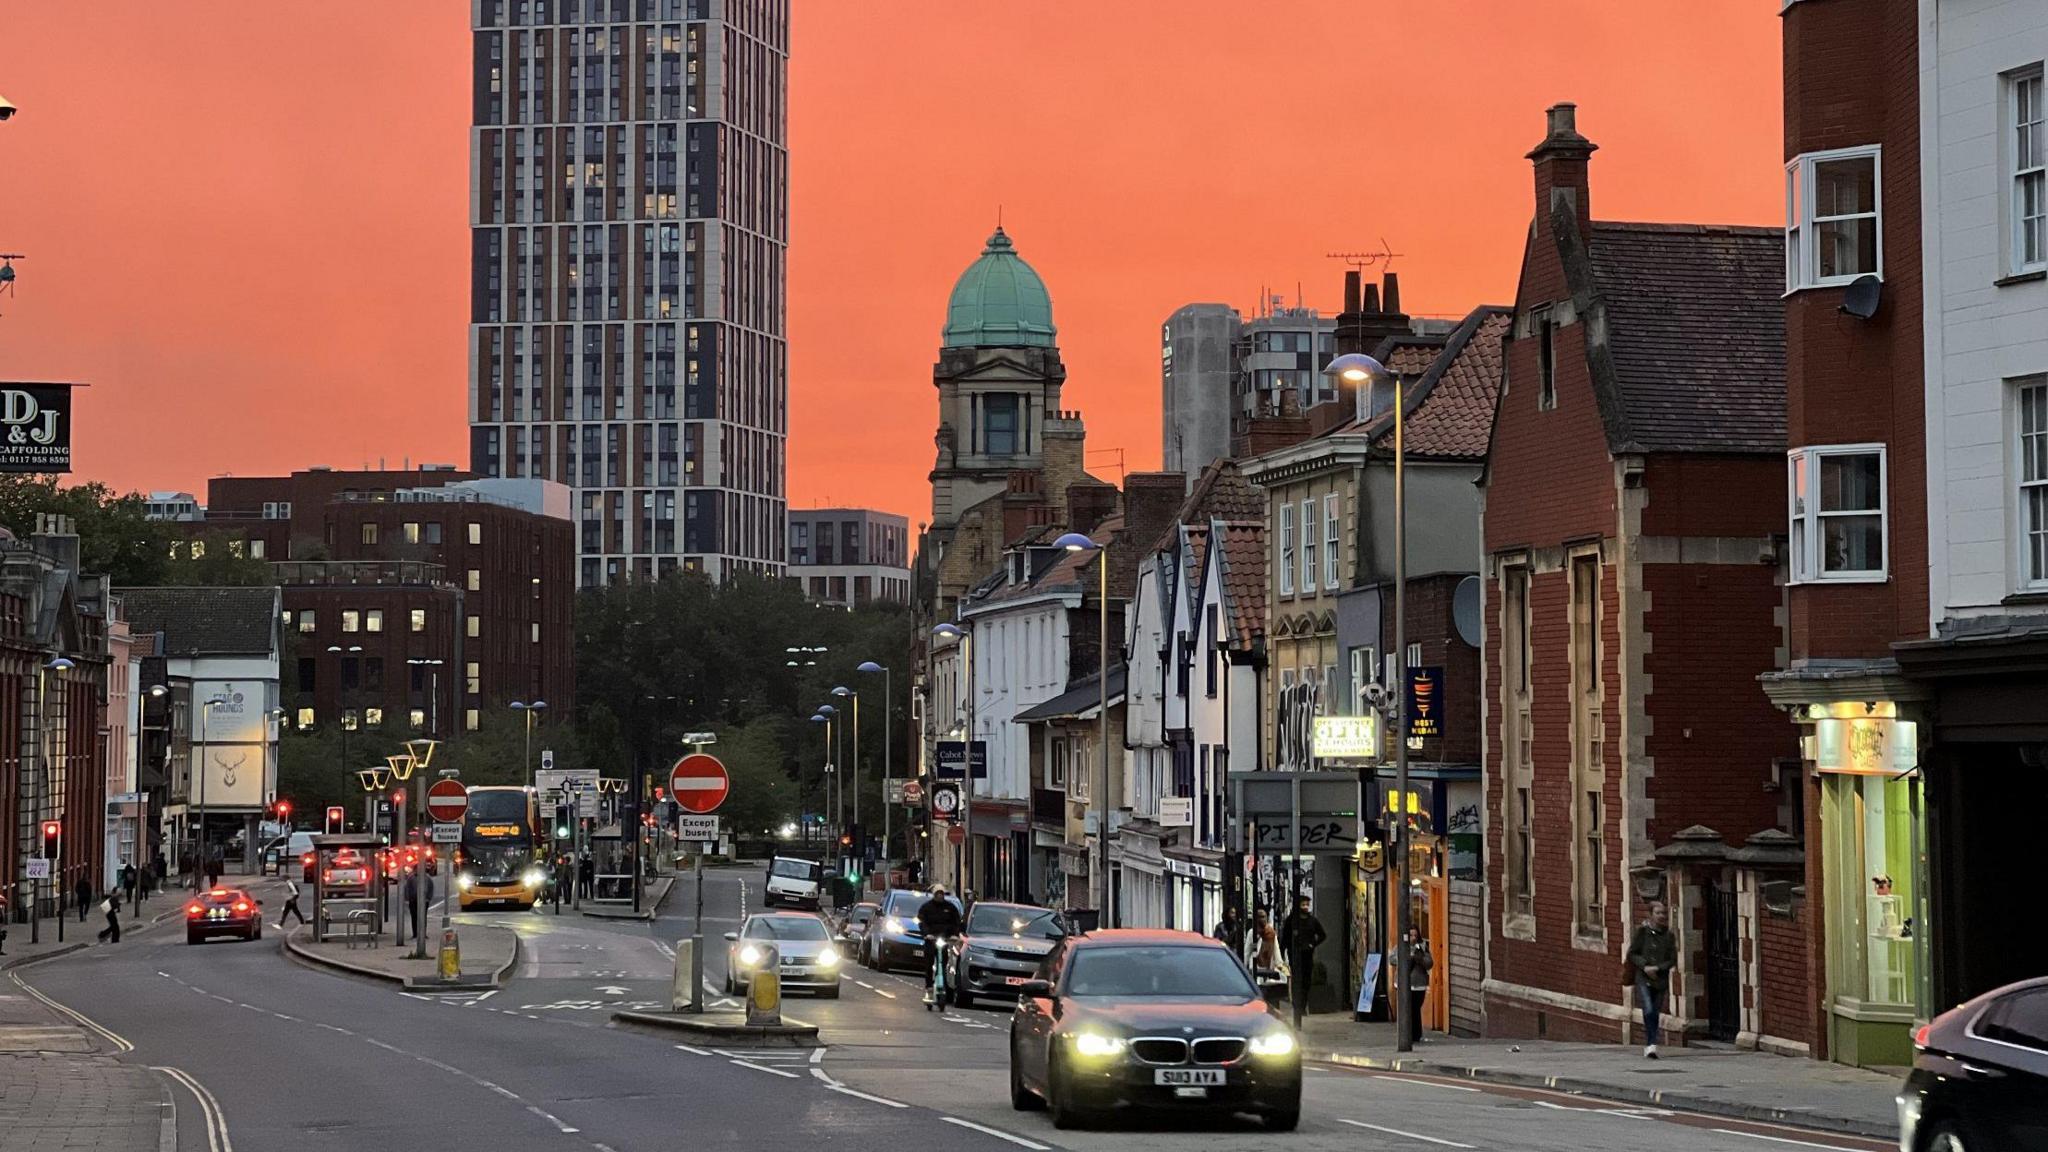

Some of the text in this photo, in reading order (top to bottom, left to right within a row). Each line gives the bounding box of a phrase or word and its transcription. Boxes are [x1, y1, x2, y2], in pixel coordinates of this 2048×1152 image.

[8, 425, 27, 444] &
[31, 410, 60, 444] J
[1414, 719, 1434, 727] BEST
[1411, 727, 1437, 735] KEBAB
[940, 750, 962, 758] Cabot
[683, 818, 715, 828] Except
[1194, 1071, 1218, 1082] AYA
